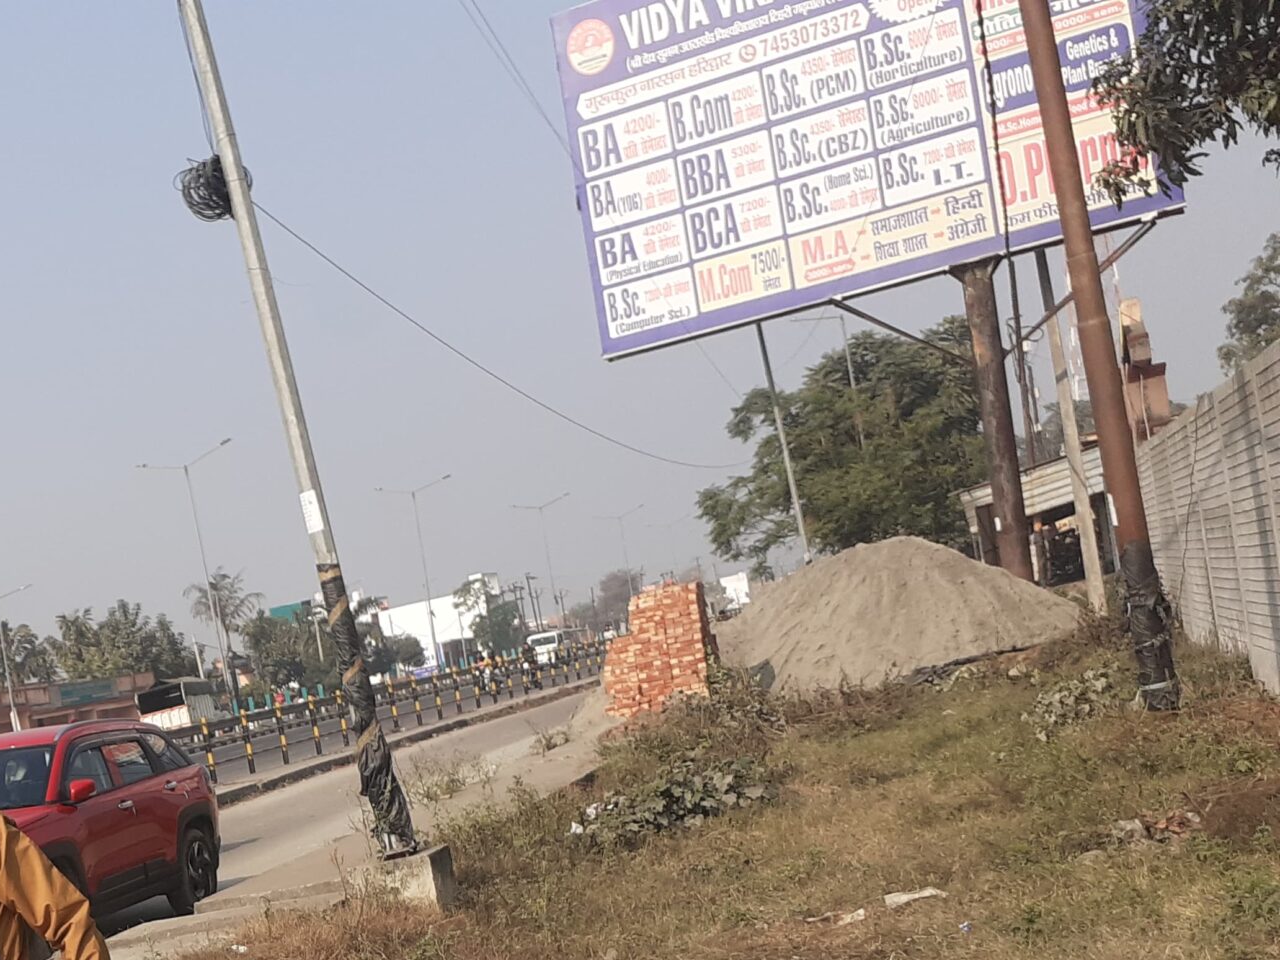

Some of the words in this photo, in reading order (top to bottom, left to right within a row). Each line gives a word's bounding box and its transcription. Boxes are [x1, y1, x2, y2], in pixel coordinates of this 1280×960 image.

[618, 0, 710, 50] VIDYA
[758, 9, 862, 57] 7453073372
[1065, 35, 1108, 61] Genetics
[1109, 28, 1119, 48] &
[863, 32, 911, 72] B.Sc.
[869, 46, 964, 88] (Horticulture)
[766, 67, 807, 116] B.Sc.
[810, 68, 857, 104] (PCM)
[623, 112, 660, 136] 4200/-
[671, 94, 733, 144] B.Com
[872, 94, 914, 130] B.Sc.
[880, 106, 970, 147] (Agriculture)
[581, 123, 622, 173] BA
[774, 128, 816, 172] B.Sc.
[817, 127, 869, 163] (CBZ)
[681, 148, 732, 201] BBA
[883, 151, 925, 190] B.Sc.
[590, 180, 617, 219] BA
[782, 181, 829, 223] B.Sc.
[690, 202, 741, 254] BCA
[598, 232, 638, 269] BA
[751, 247, 786, 276] 7500/-
[698, 262, 753, 305] M.Com
[607, 287, 646, 323] B.Sc.
